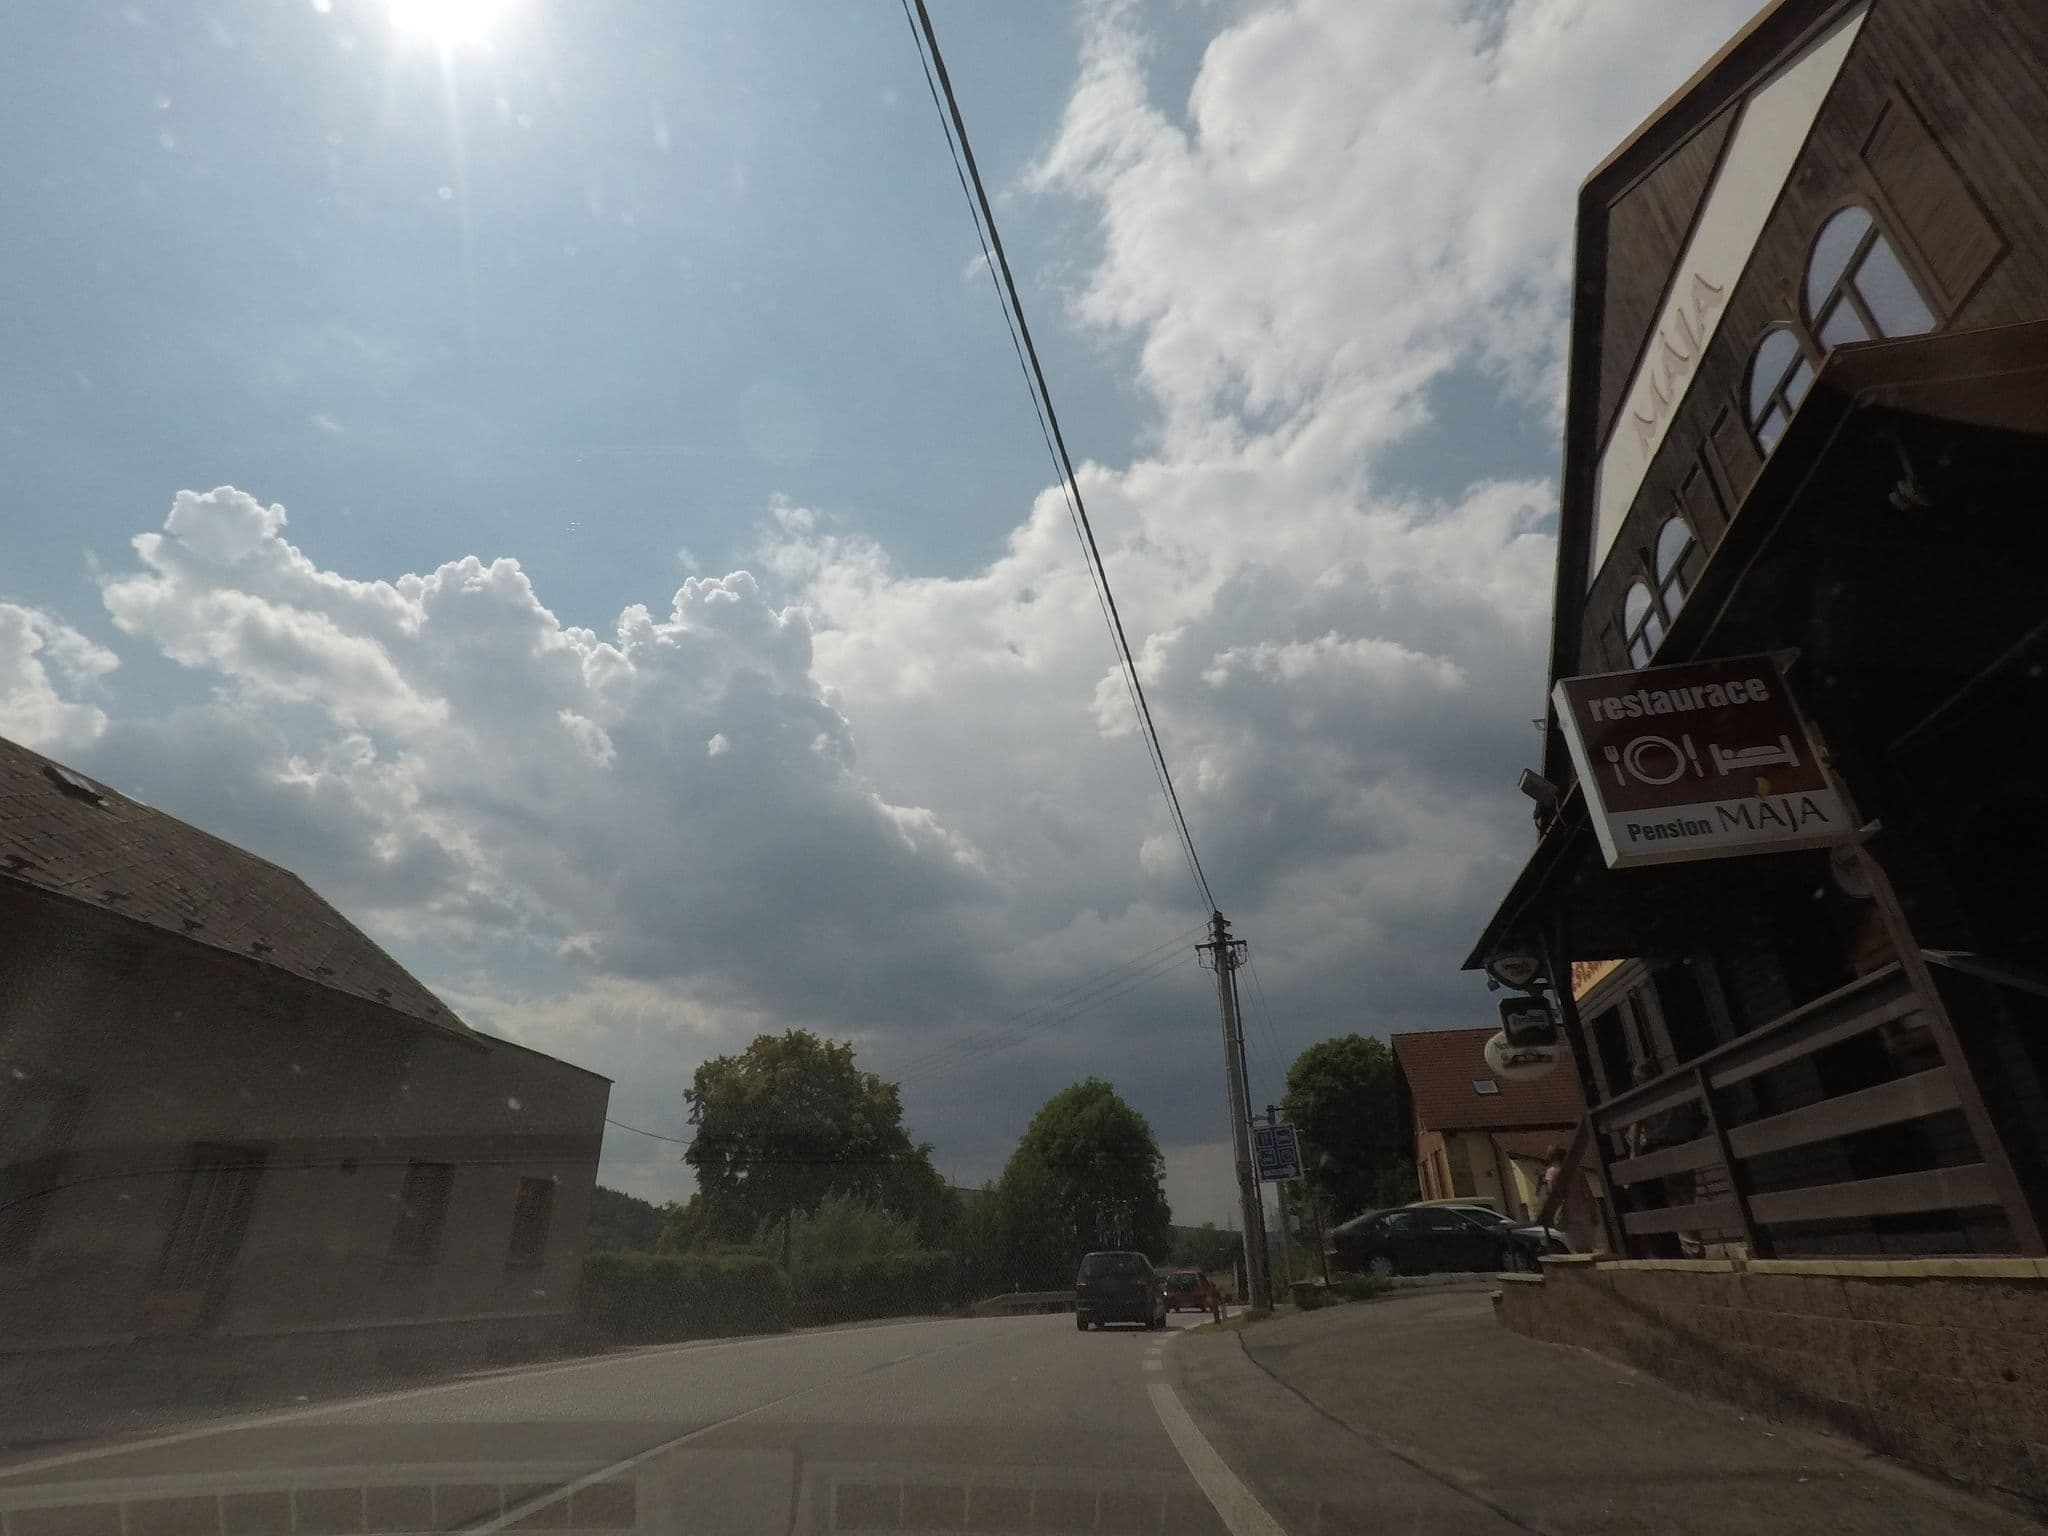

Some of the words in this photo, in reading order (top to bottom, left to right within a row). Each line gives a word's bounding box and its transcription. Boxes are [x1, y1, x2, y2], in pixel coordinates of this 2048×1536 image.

[1589, 678, 1769, 722] restaurace
[1627, 815, 1713, 842] Pension
[1716, 797, 1829, 832] MAJA
